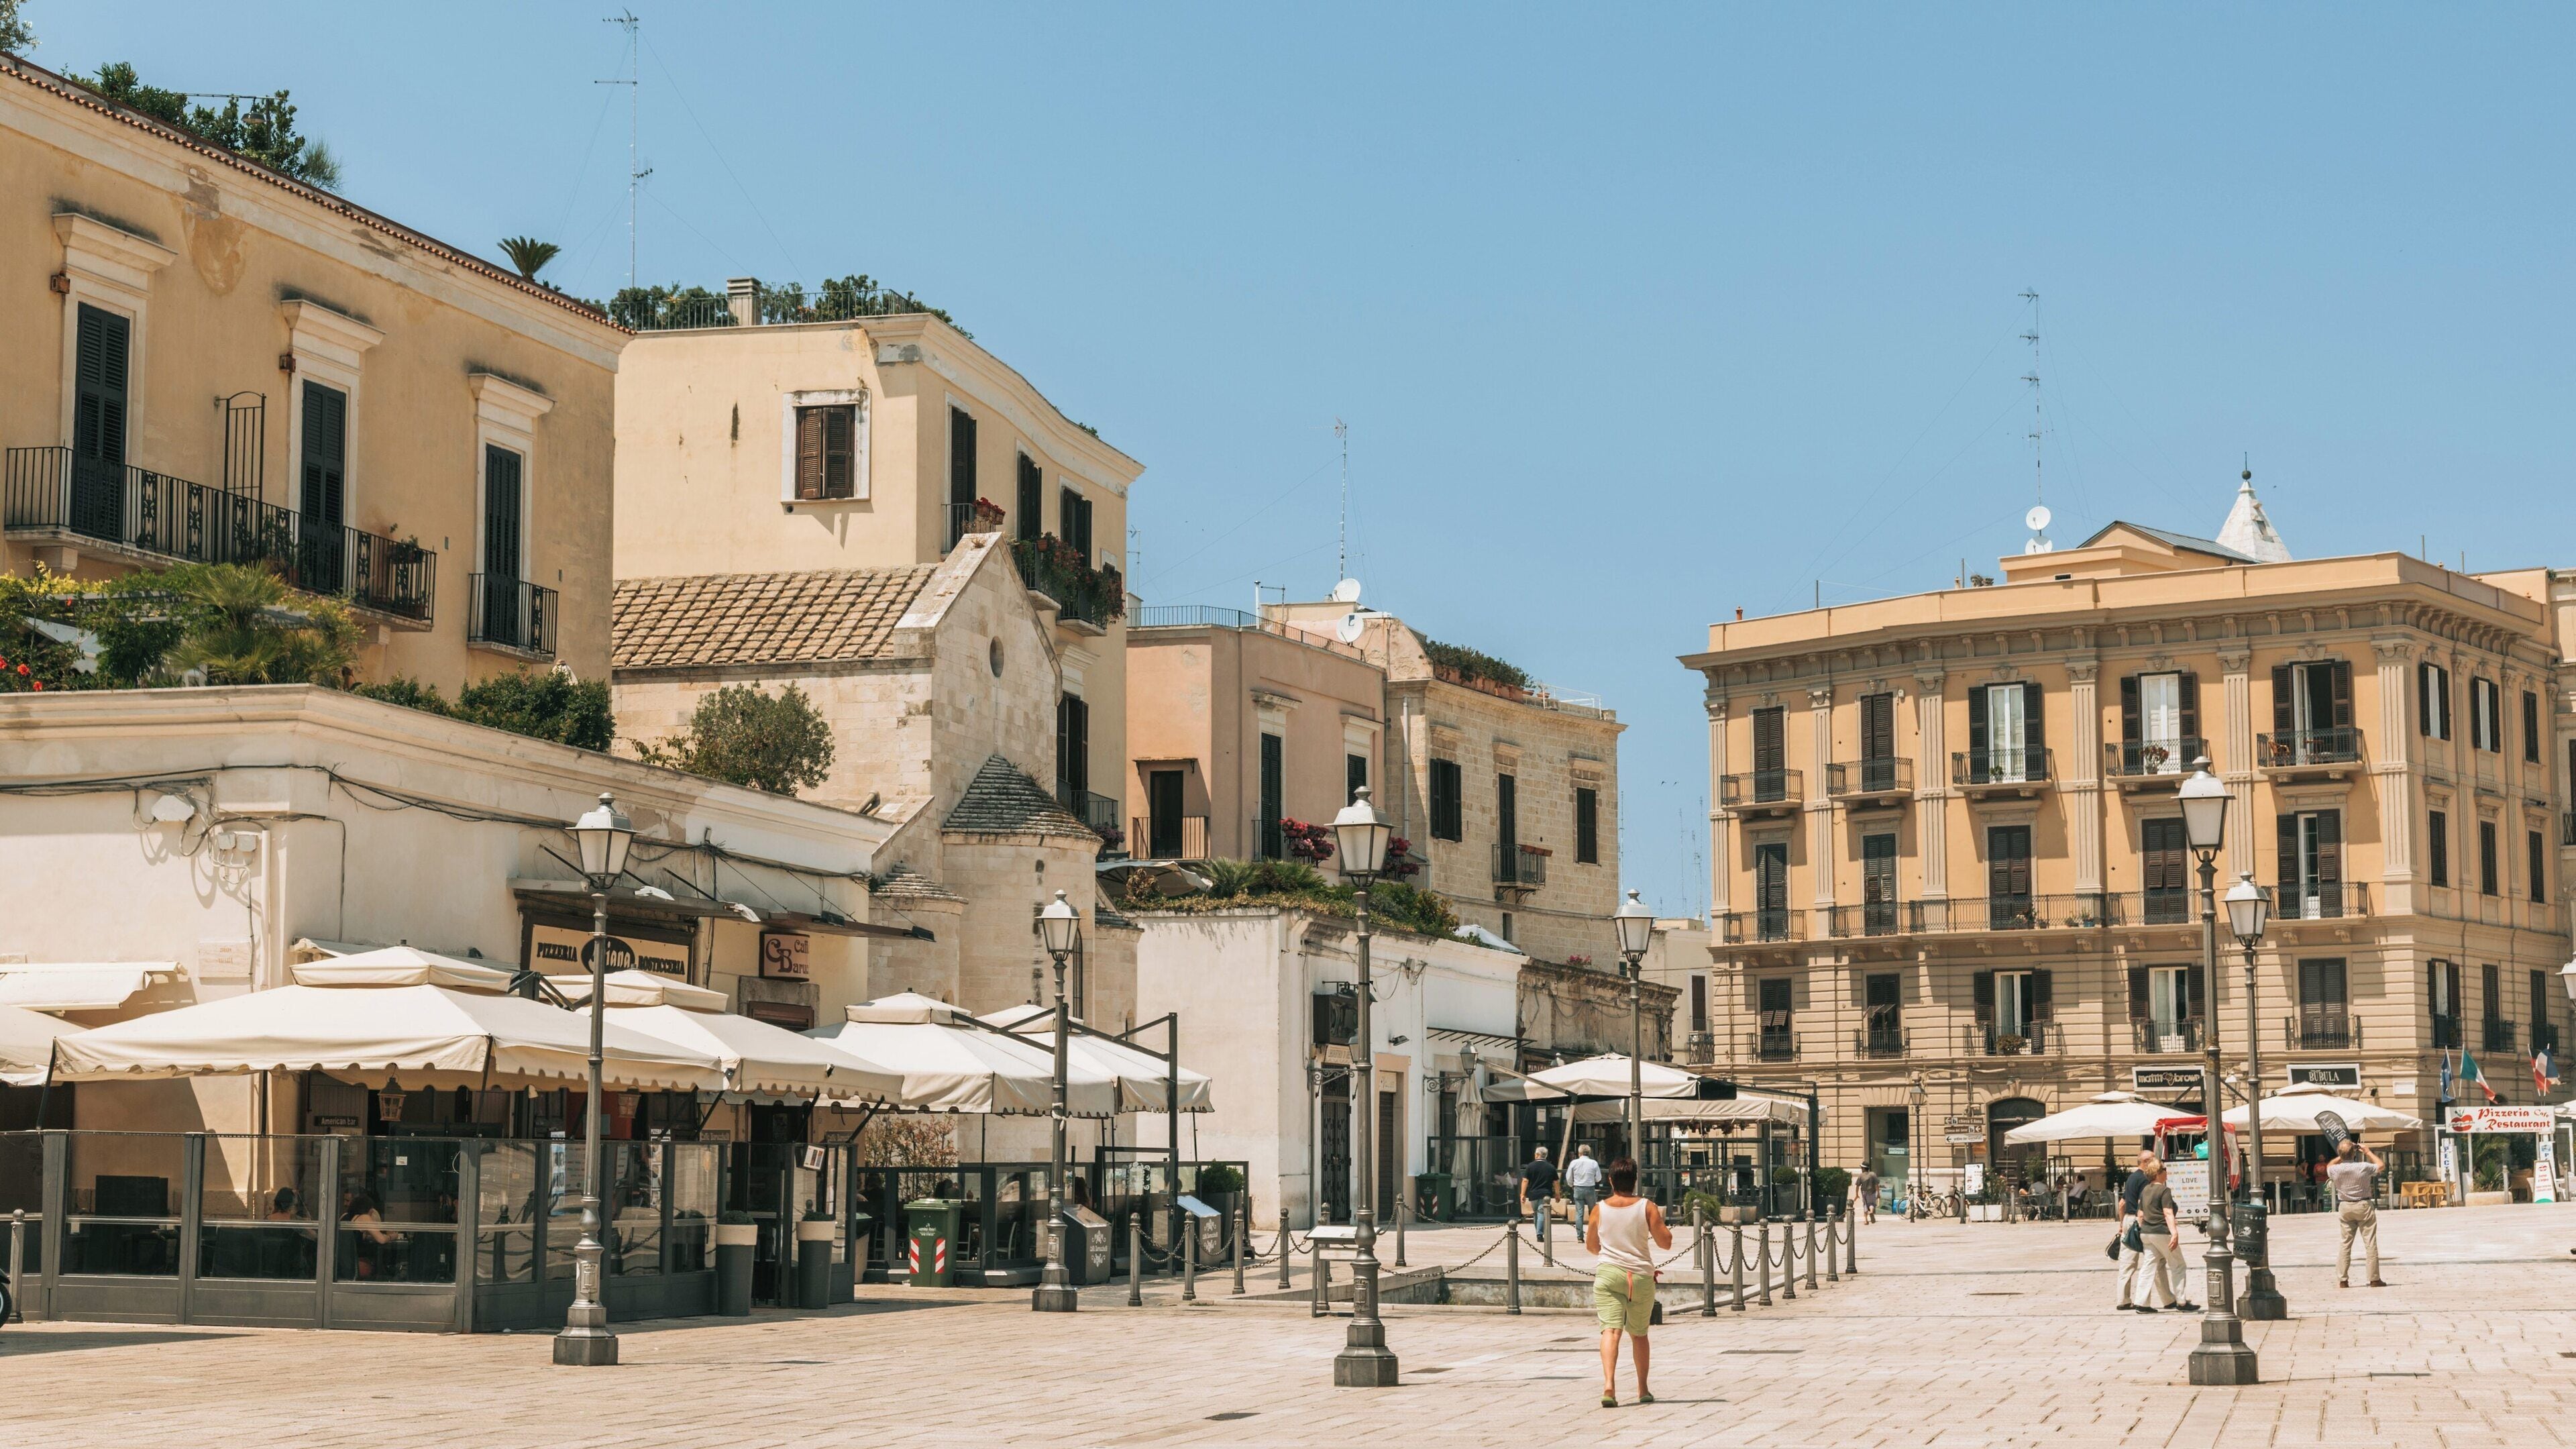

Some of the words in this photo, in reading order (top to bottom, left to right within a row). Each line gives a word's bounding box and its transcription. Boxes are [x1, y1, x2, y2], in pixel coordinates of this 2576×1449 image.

[537, 943, 578, 962] PIZZERIA
[2308, 1071, 2340, 1081] BUBULA
[2478, 1108, 2529, 1120] Pizzeria
[321, 1117, 346, 1125] American
[2485, 1118, 2551, 1130] Restaurant
